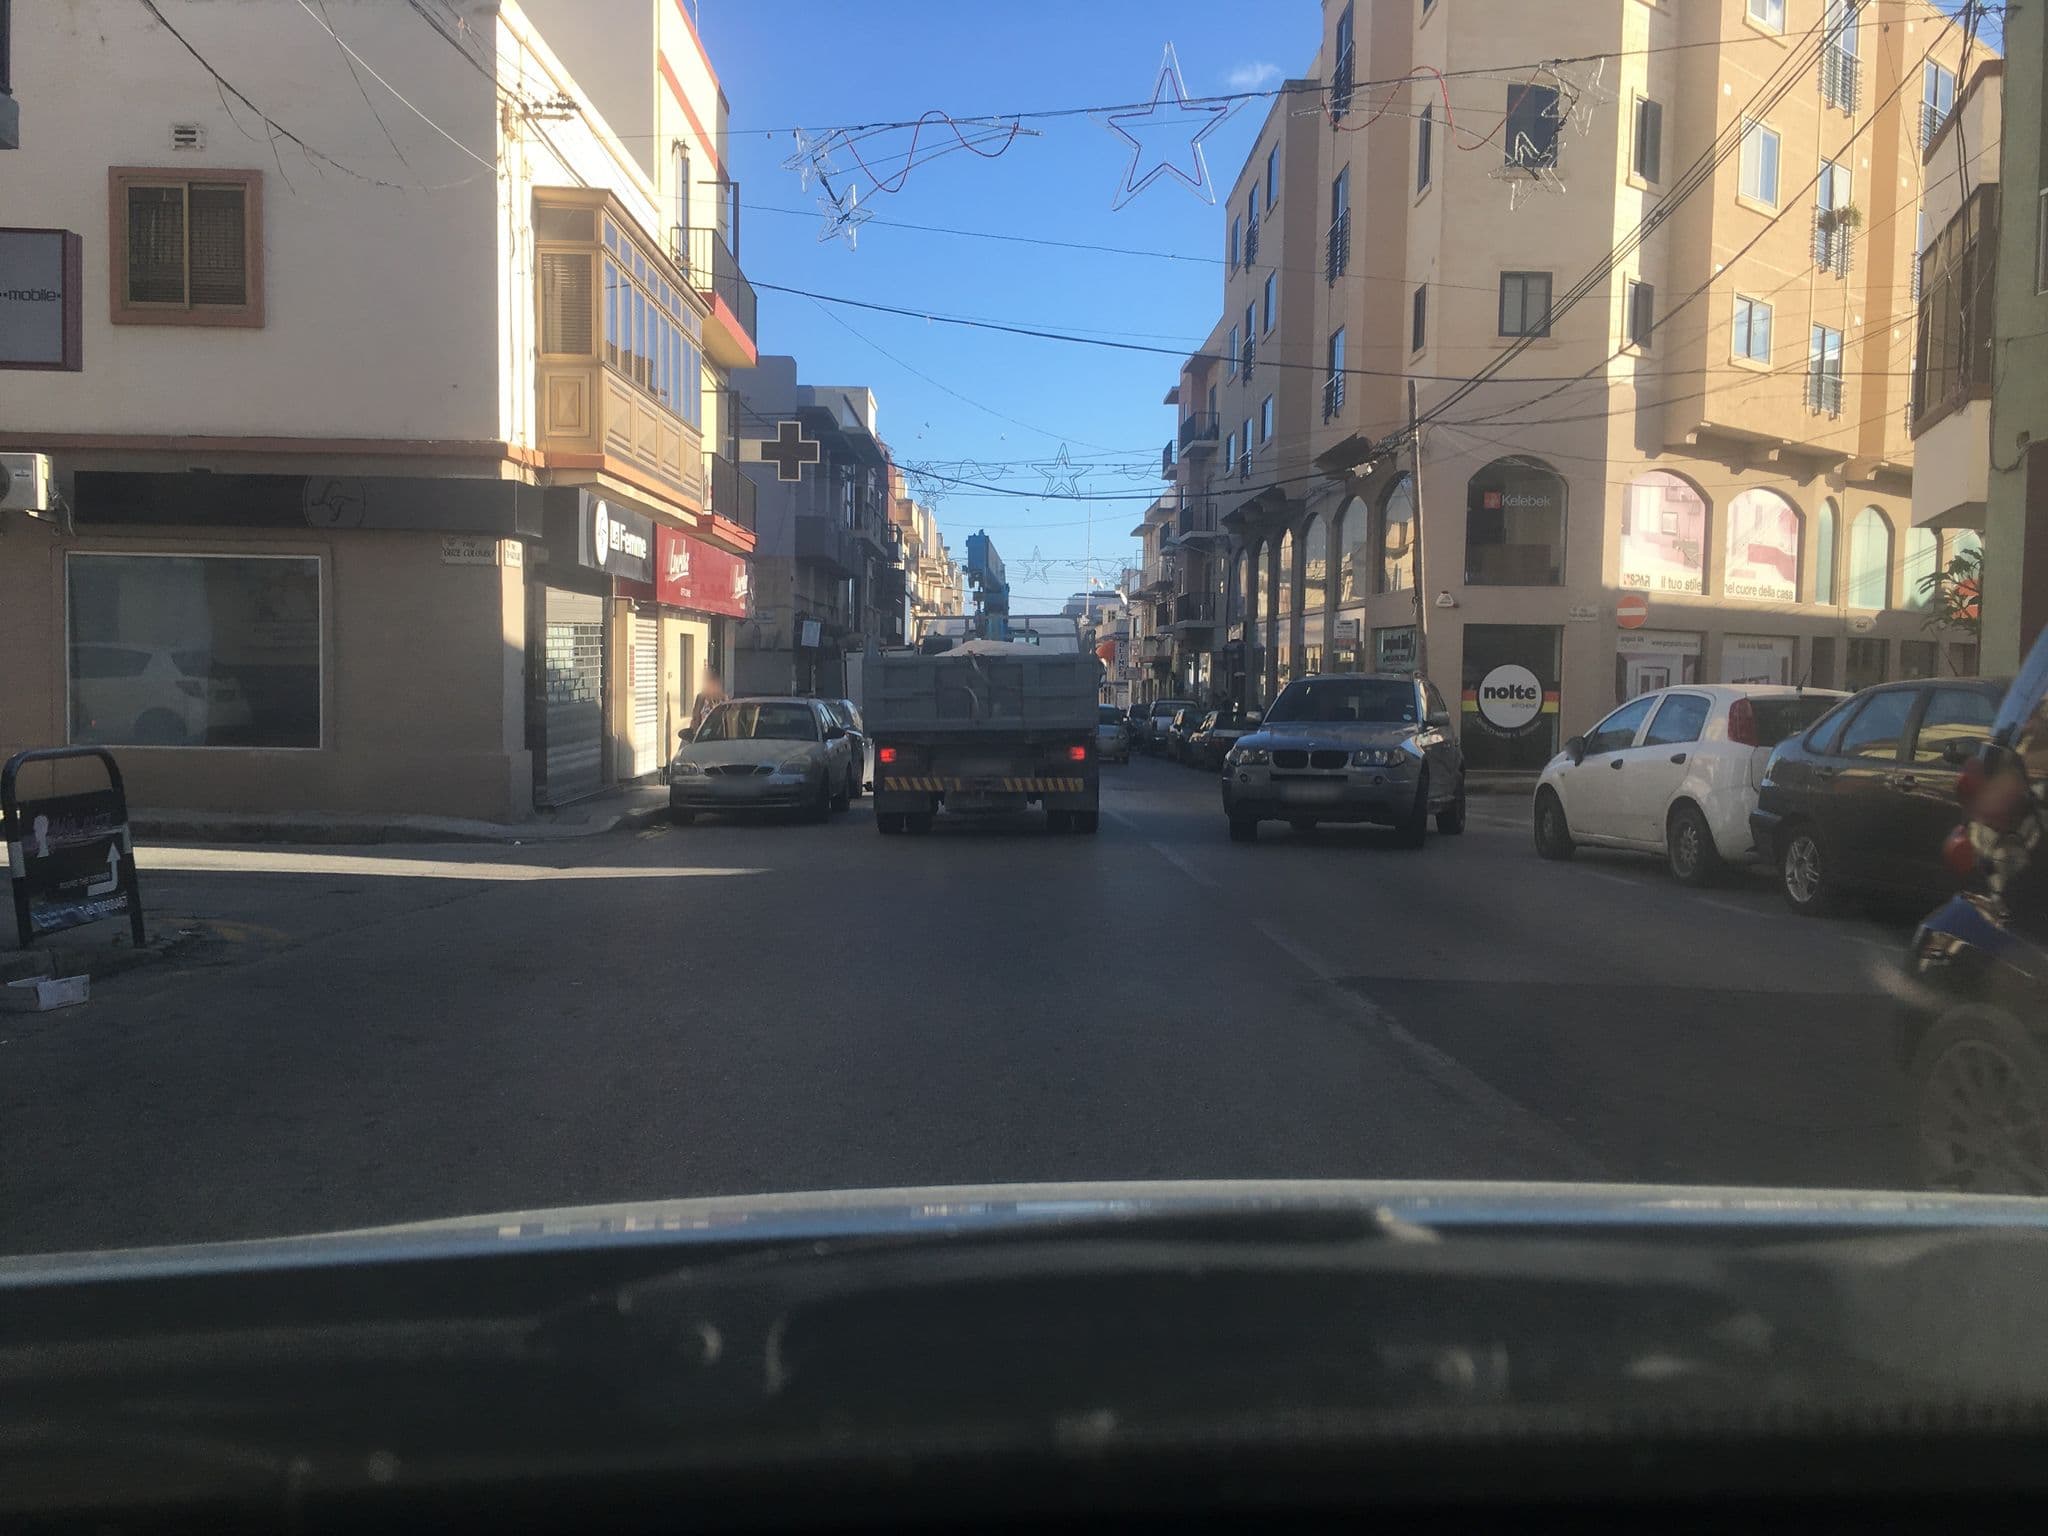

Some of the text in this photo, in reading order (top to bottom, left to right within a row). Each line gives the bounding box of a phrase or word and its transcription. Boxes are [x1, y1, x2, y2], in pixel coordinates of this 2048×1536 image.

[1501, 494, 1551, 507] Kelebek
[620, 523, 647, 560] Femme
[1668, 576, 1683, 590] tuo
[1684, 577, 1702, 592] stile
[1736, 584, 1757, 596] cuore
[1758, 584, 1775, 598] della
[1776, 589, 1794, 600] casa
[1483, 684, 1537, 700] nolte
